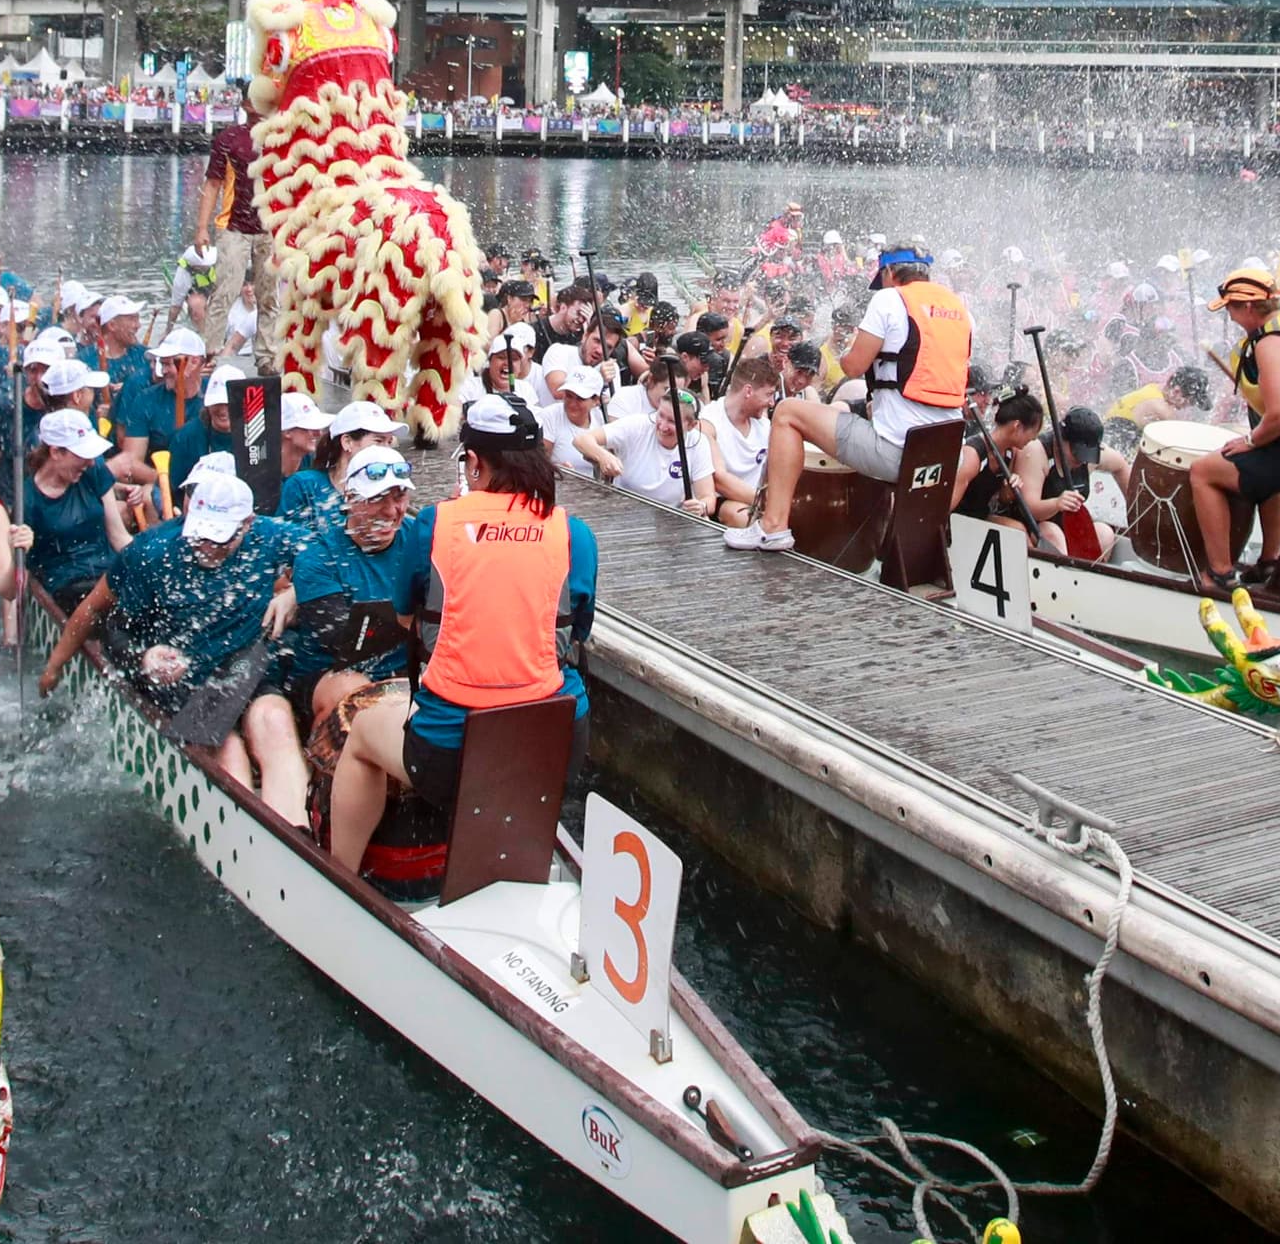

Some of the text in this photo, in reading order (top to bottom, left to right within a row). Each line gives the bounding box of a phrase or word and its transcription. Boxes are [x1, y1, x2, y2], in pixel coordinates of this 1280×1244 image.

[249, 445, 259, 465] 380
[915, 465, 942, 485] 44
[464, 522, 544, 544] Vaikobi
[970, 528, 1011, 619] 4
[603, 830, 651, 1005] 3
[502, 951, 569, 1013] NO STANDING
[588, 1116, 622, 1163] BuK
